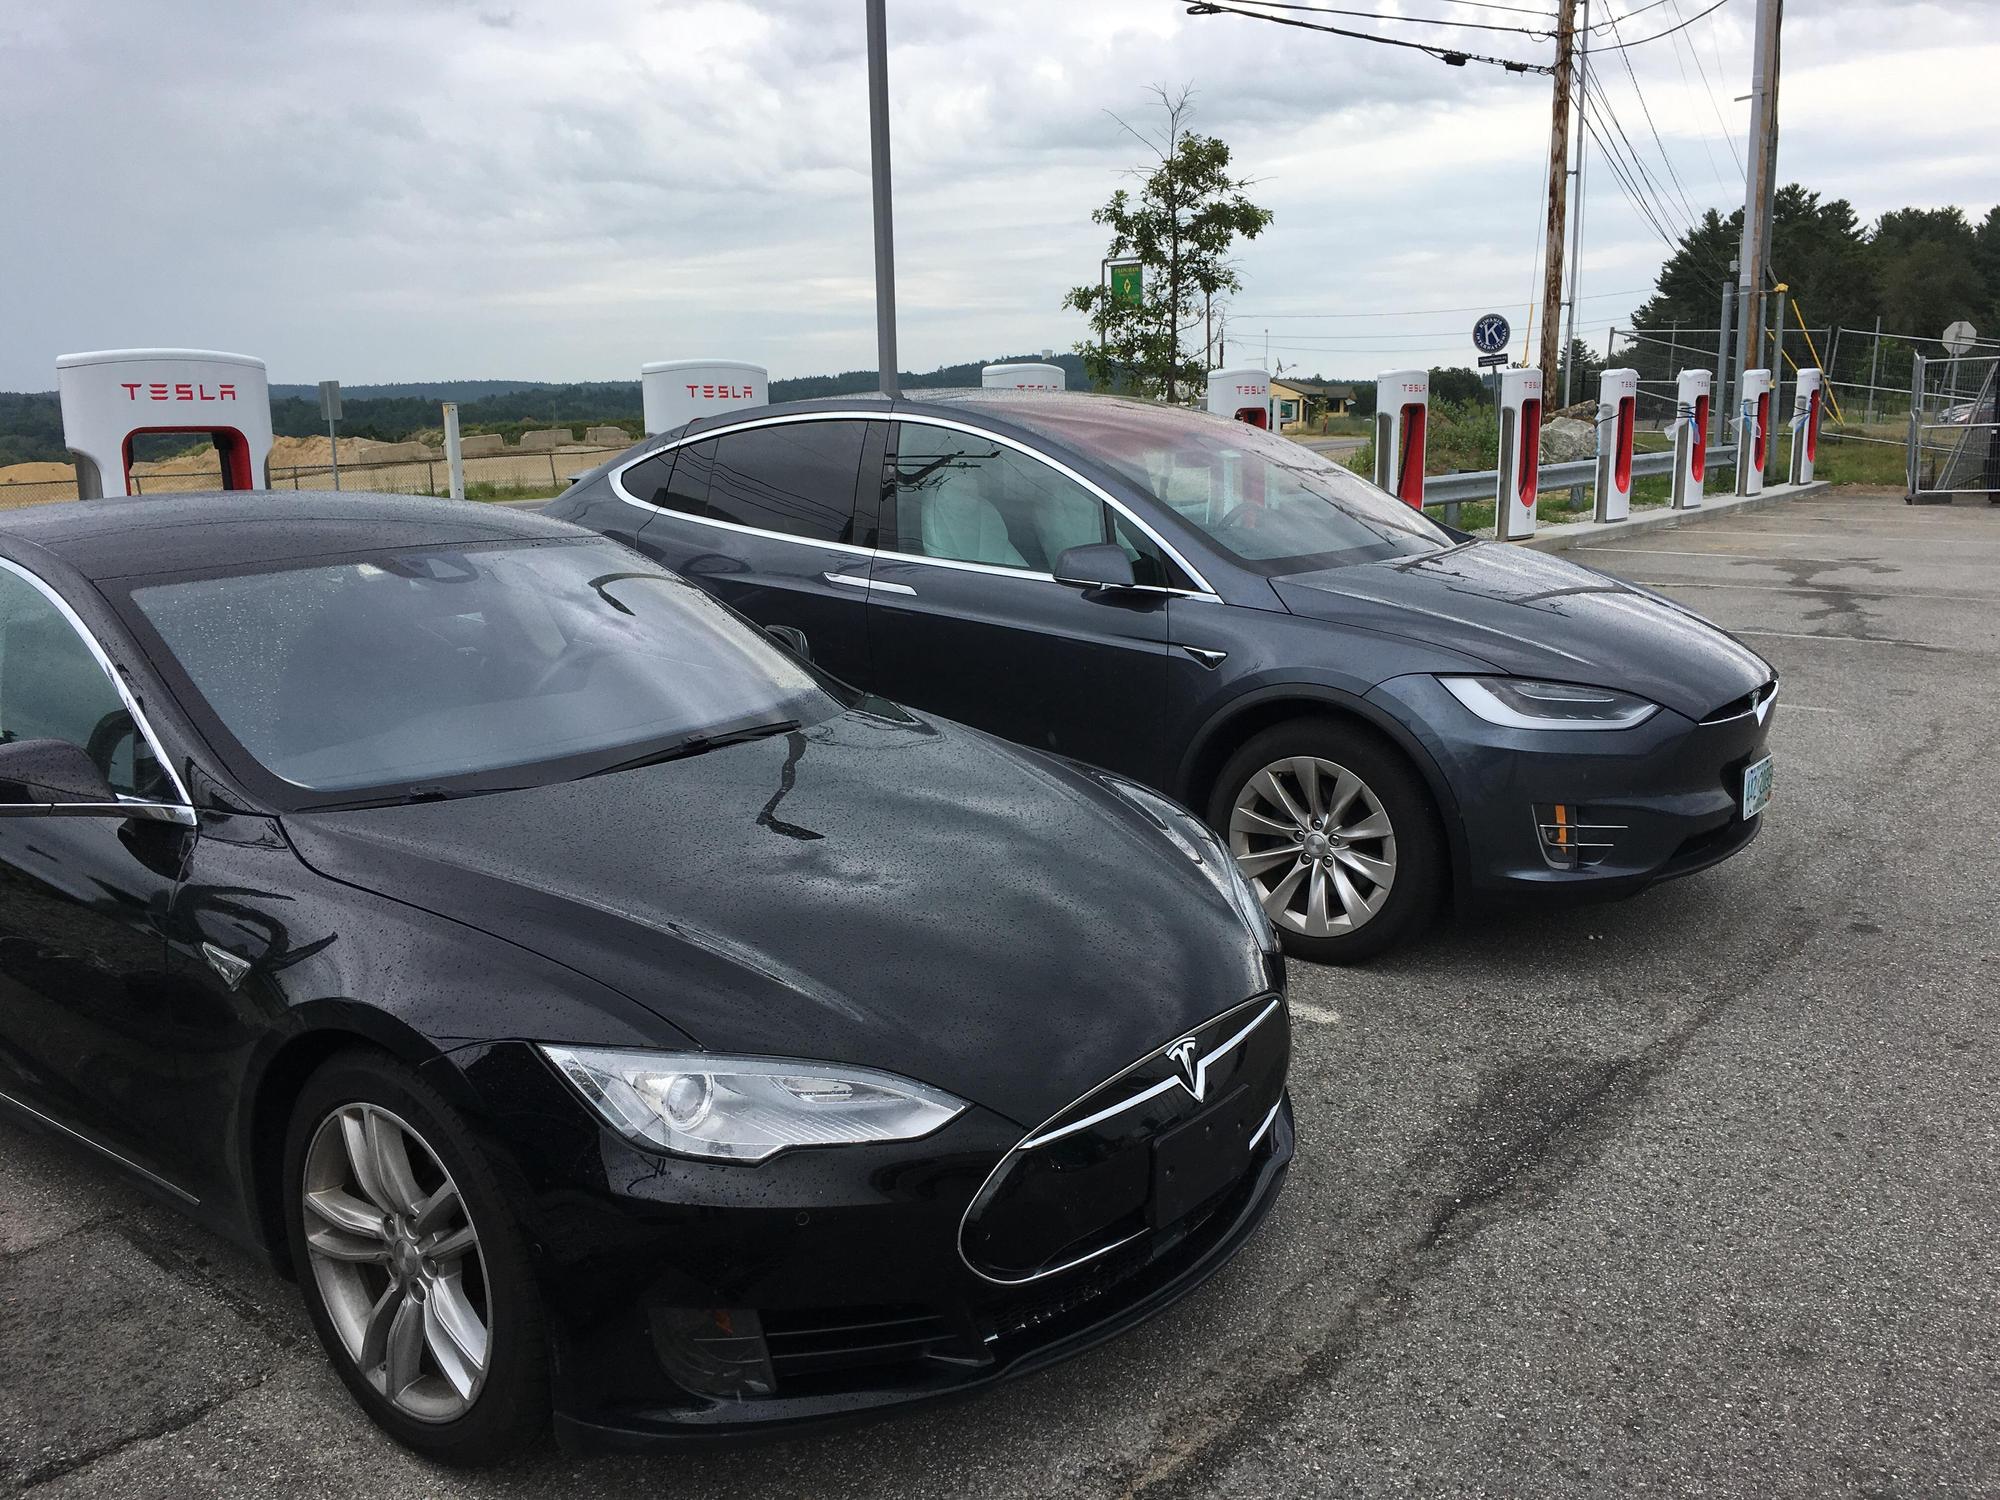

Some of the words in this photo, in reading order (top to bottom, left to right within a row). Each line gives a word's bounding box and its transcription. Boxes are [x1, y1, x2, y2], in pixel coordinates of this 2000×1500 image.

[1479, 318, 1502, 329] KIWANIS
[1476, 328, 1507, 350] INTERNATIONAL
[1484, 322, 1501, 346] K
[120, 383, 236, 401] TESLA
[686, 385, 753, 399] TESLA
[1236, 385, 1266, 395] TESLA
